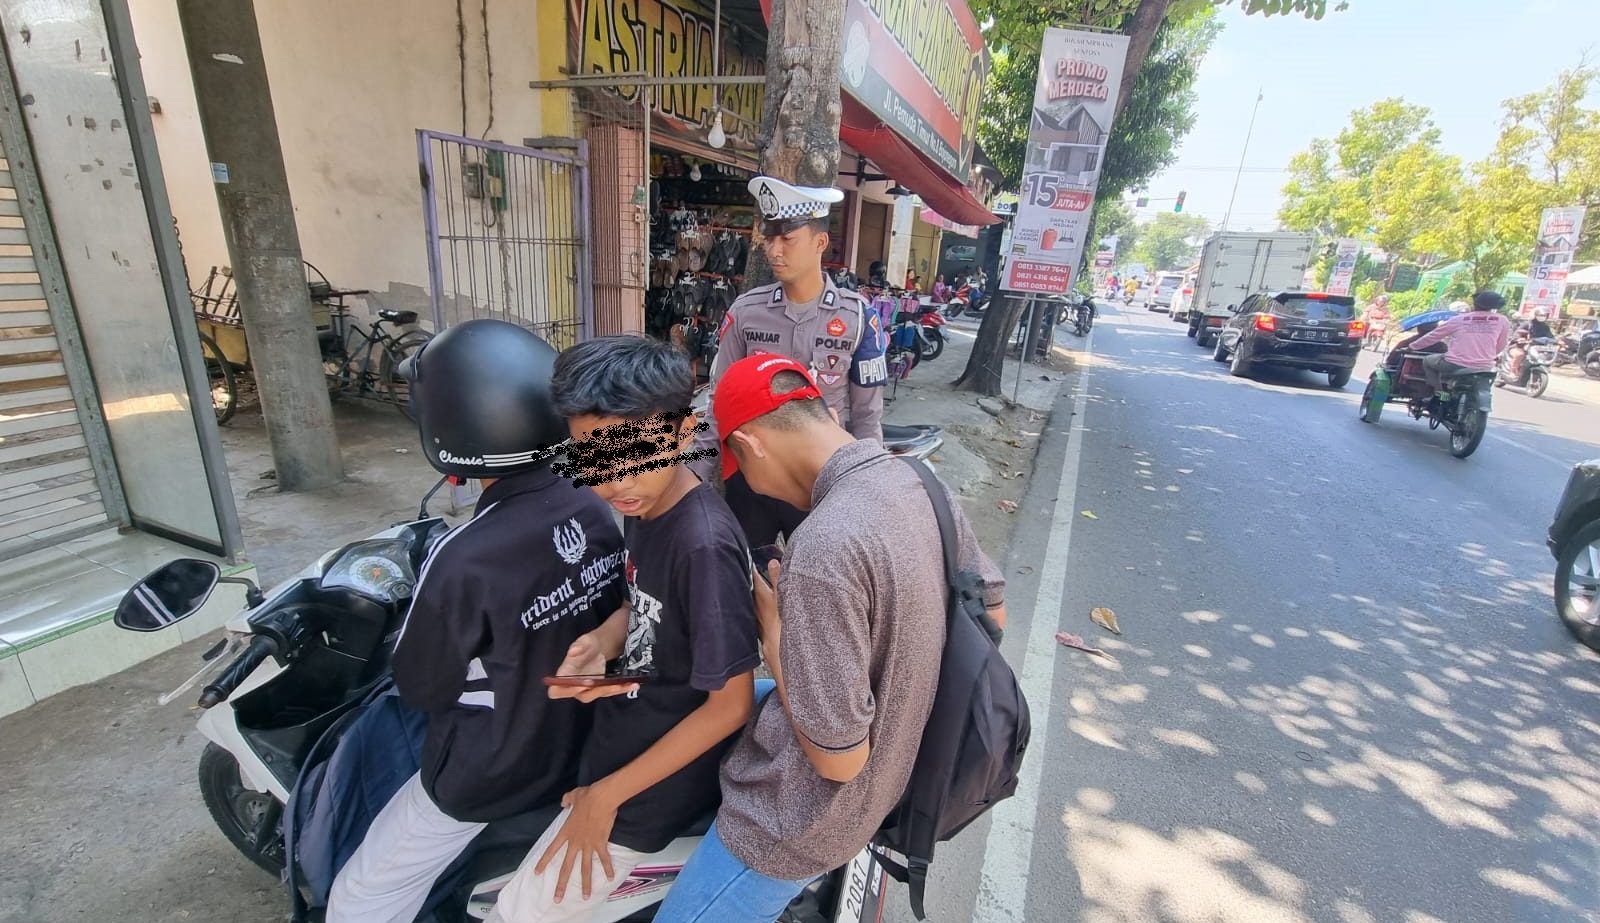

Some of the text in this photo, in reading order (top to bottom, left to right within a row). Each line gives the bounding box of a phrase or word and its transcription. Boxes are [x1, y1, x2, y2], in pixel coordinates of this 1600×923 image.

[580, 0, 715, 126] ASTRIA
[1056, 58, 1108, 82] PROMO
[1049, 80, 1109, 101] MERDEKA
[1028, 174, 1059, 207] 15
[745, 330, 851, 351] YANUAR POLRI
[439, 450, 484, 465] Classic
[520, 577, 575, 629] trident
[846, 858, 867, 920] 2087
